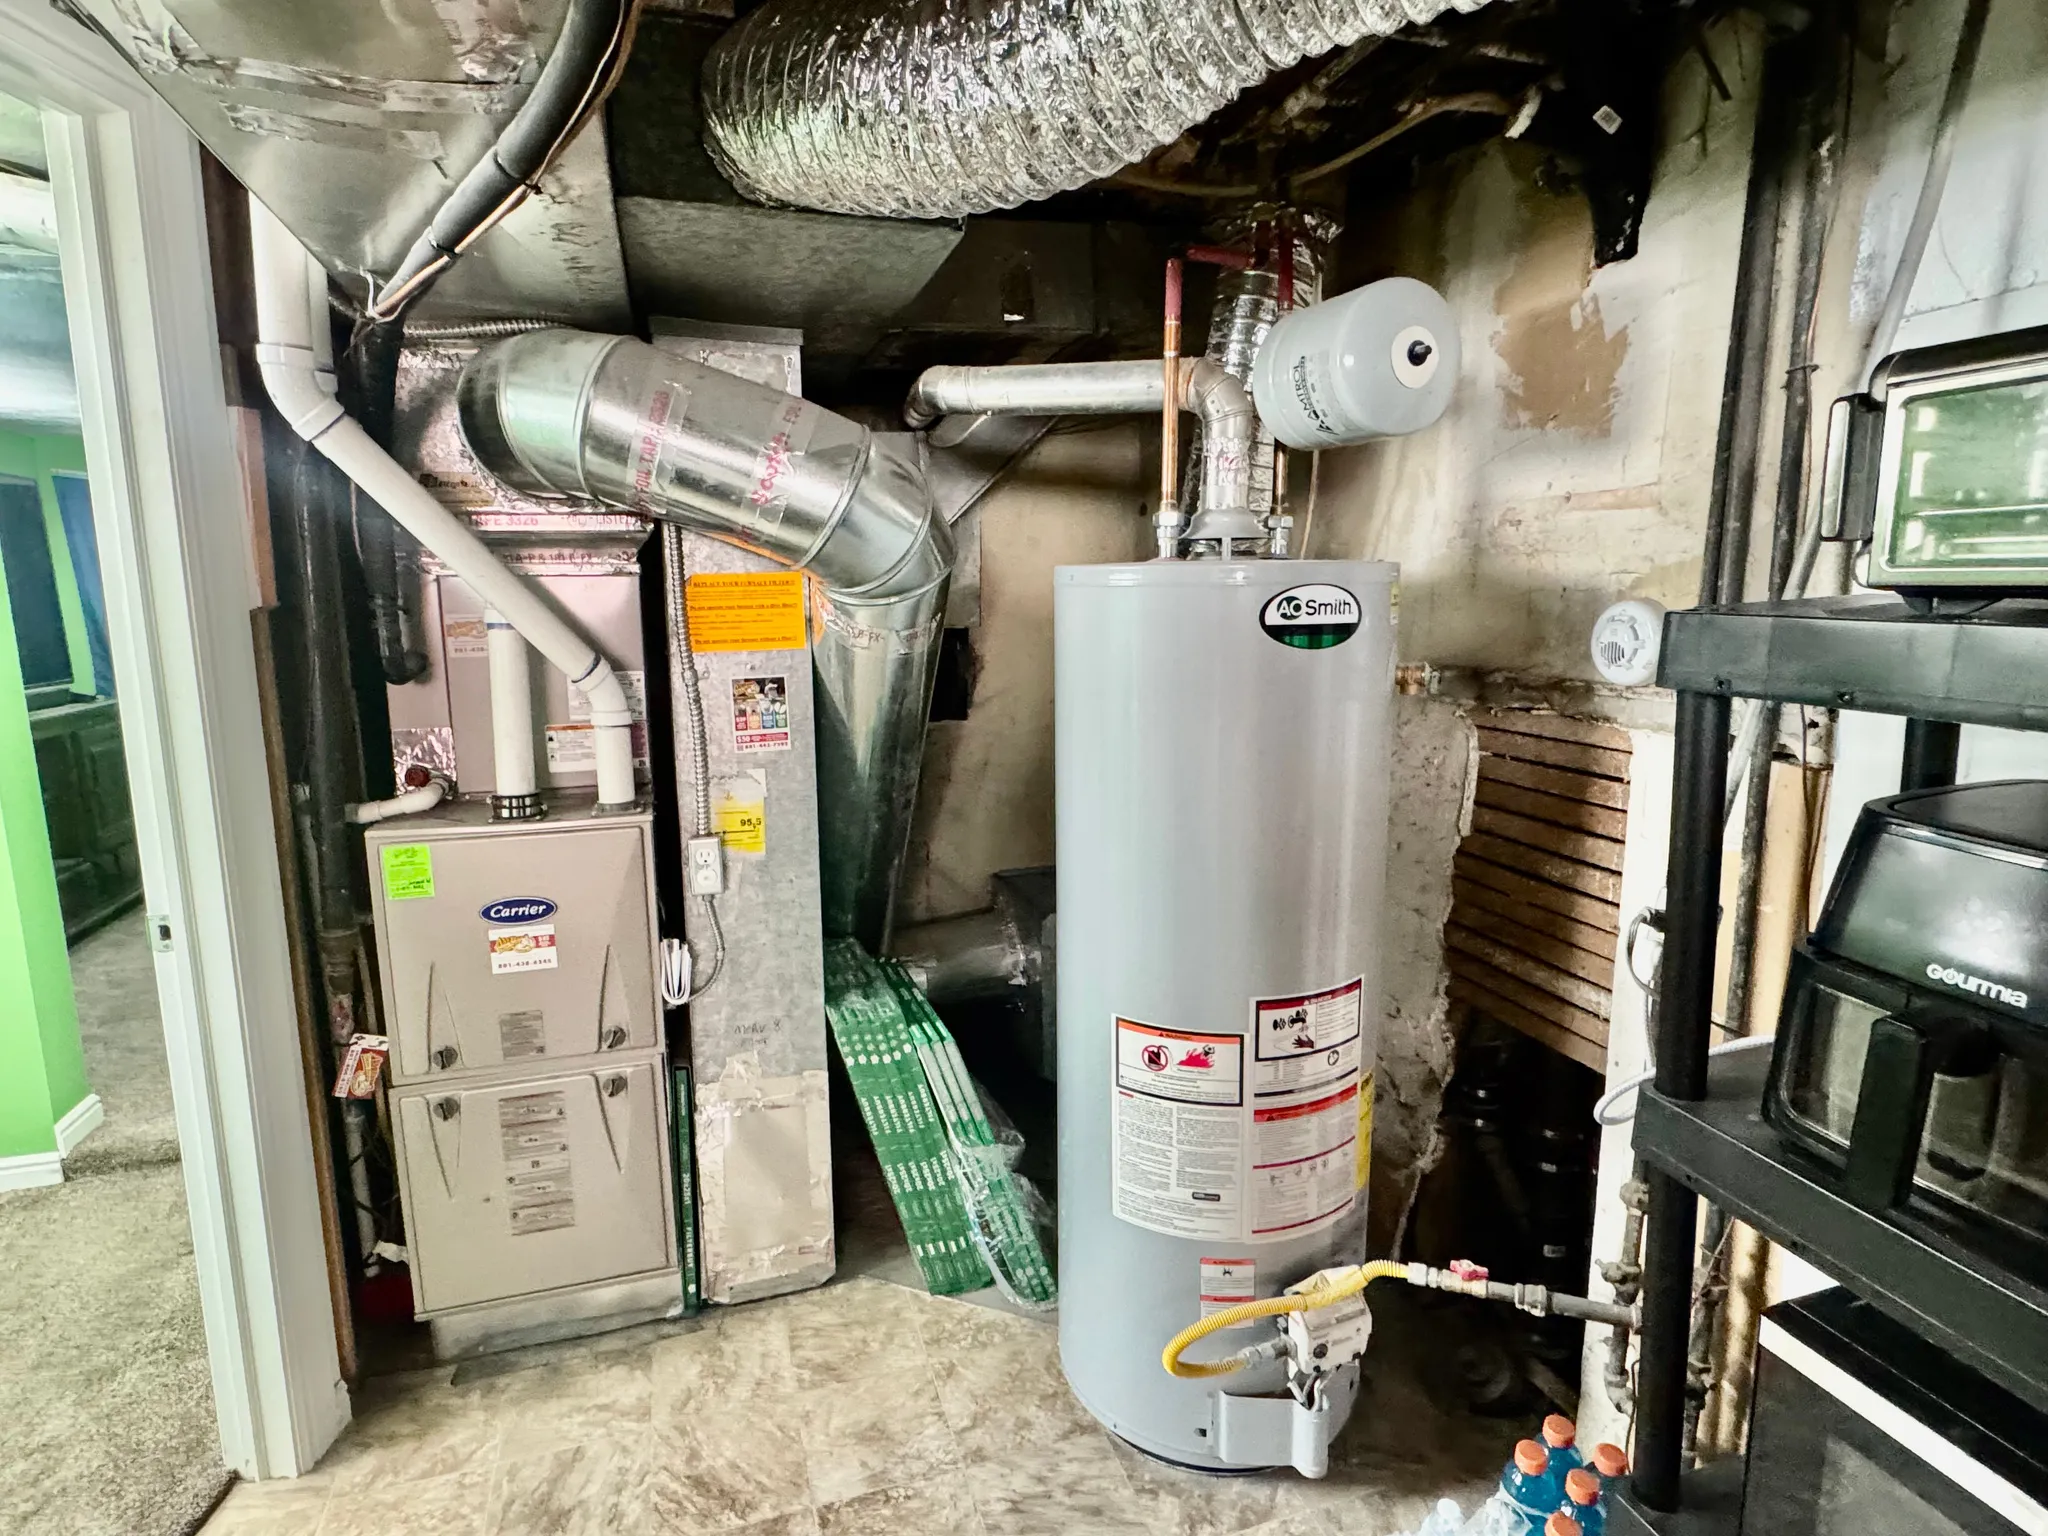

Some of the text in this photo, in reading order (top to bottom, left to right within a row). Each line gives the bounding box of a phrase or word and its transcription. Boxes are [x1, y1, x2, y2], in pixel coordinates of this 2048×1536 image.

[1304, 598, 1352, 616] Smith
[489, 903, 548, 919] Carrier
[1925, 963, 2028, 1009] Gourmia
